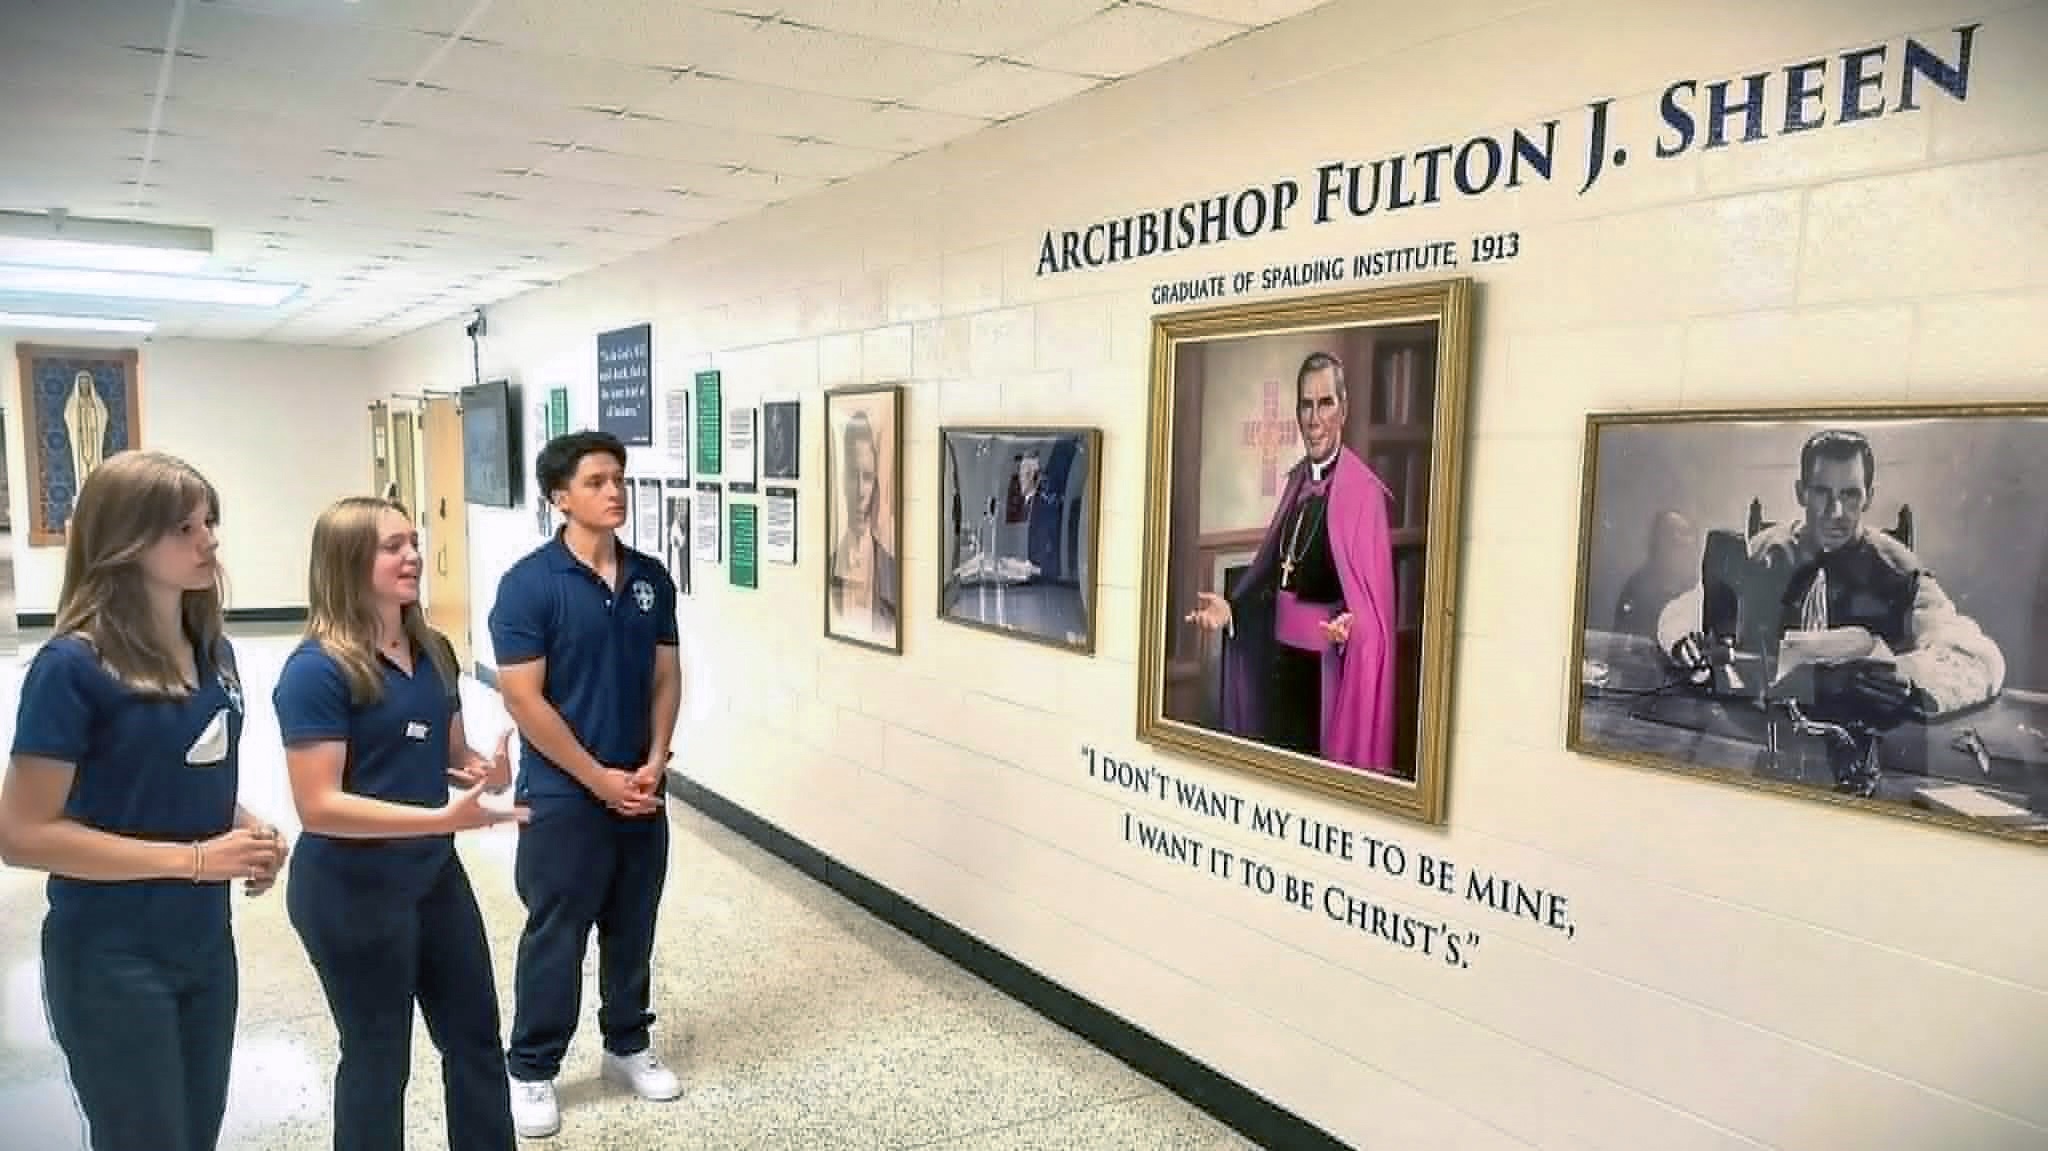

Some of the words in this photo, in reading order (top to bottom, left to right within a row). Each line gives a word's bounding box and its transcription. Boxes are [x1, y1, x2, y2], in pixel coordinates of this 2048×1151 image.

[1036, 181, 1298, 276] ARCHBISHOP
[1314, 120, 1560, 224] FULTON
[1577, 97, 1626, 195] J.
[1656, 23, 1982, 158] SHEEN
[1152, 276, 1225, 304] GRADUATE
[1233, 271, 1255, 293] OF
[1261, 257, 1344, 289] SPALDING
[1353, 241, 1457, 278] INSTITUTE,
[1472, 232, 1519, 262] 1913
[1103, 756, 1170, 800] DON'T
[1176, 779, 1244, 824] WANT
[1251, 803, 1292, 839] MY
[1299, 817, 1352, 860] LIFE
[1363, 836, 1406, 875] TO
[1418, 853, 1455, 893] BE
[1465, 867, 1575, 938] MINE,
[1123, 812, 1132, 841] I
[1138, 821, 1203, 867] WANT
[1209, 848, 1234, 878] IT
[1240, 857, 1275, 893] TO
[1284, 875, 1314, 910] BE
